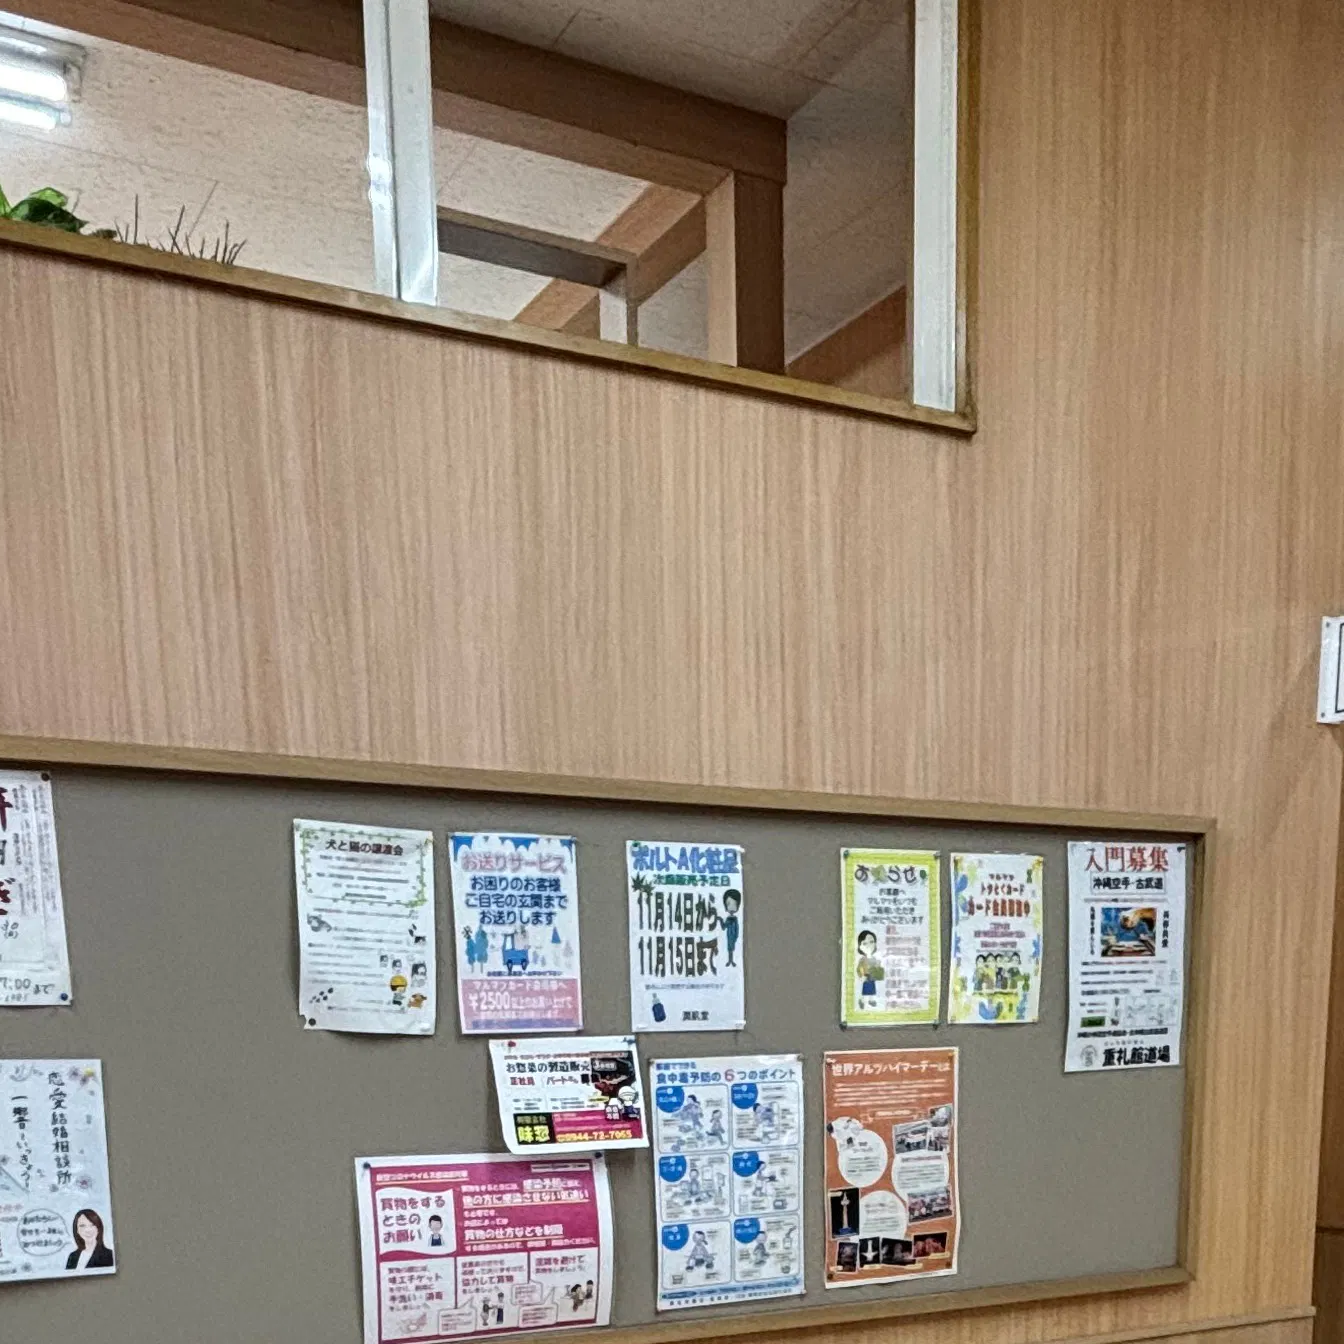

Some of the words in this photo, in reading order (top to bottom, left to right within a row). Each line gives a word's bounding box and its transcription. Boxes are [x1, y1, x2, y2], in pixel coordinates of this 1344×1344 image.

[461, 850, 567, 873] お送りサービス
[1084, 846, 1169, 873] 入門募集
[470, 876, 562, 892] お困りのお客様
[464, 893, 568, 909] ご自宅の玄関まで
[479, 909, 557, 926] お送りします
[637, 892, 718, 933] 11月14日から
[638, 935, 719, 978] 11月15日まで
[380, 1195, 446, 1211] 買物をする
[382, 1213, 422, 1227] ときの
[383, 1229, 423, 1243] お願い
